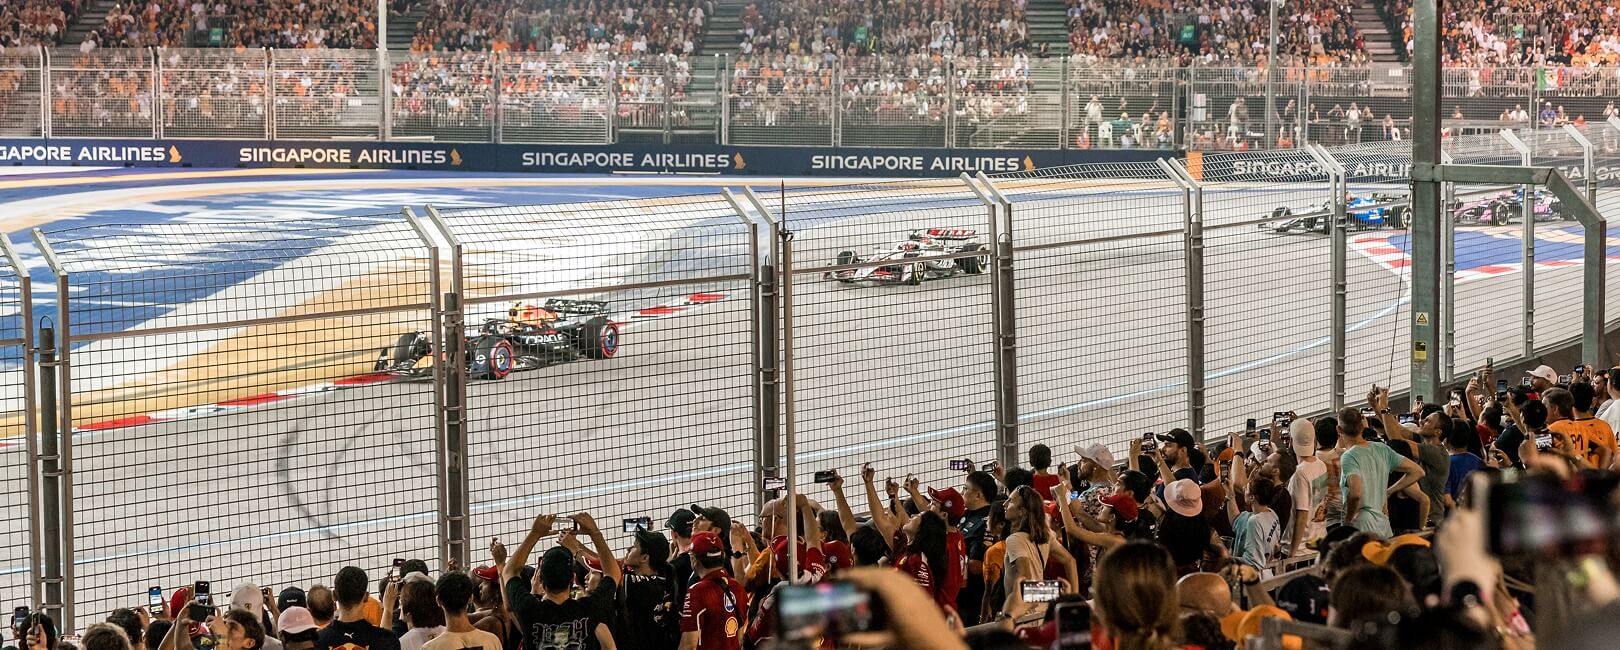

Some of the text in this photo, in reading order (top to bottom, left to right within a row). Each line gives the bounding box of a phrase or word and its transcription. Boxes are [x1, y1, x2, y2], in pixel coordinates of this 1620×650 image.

[78, 146, 165, 161] AIRLINES
[239, 148, 446, 164] SINGAPORE AIRLINES
[522, 152, 730, 168] SINGAPORE AIRLINES
[811, 155, 1020, 171] SINGAPORE AIRLINES
[1233, 160, 1326, 176] SINGAPO
